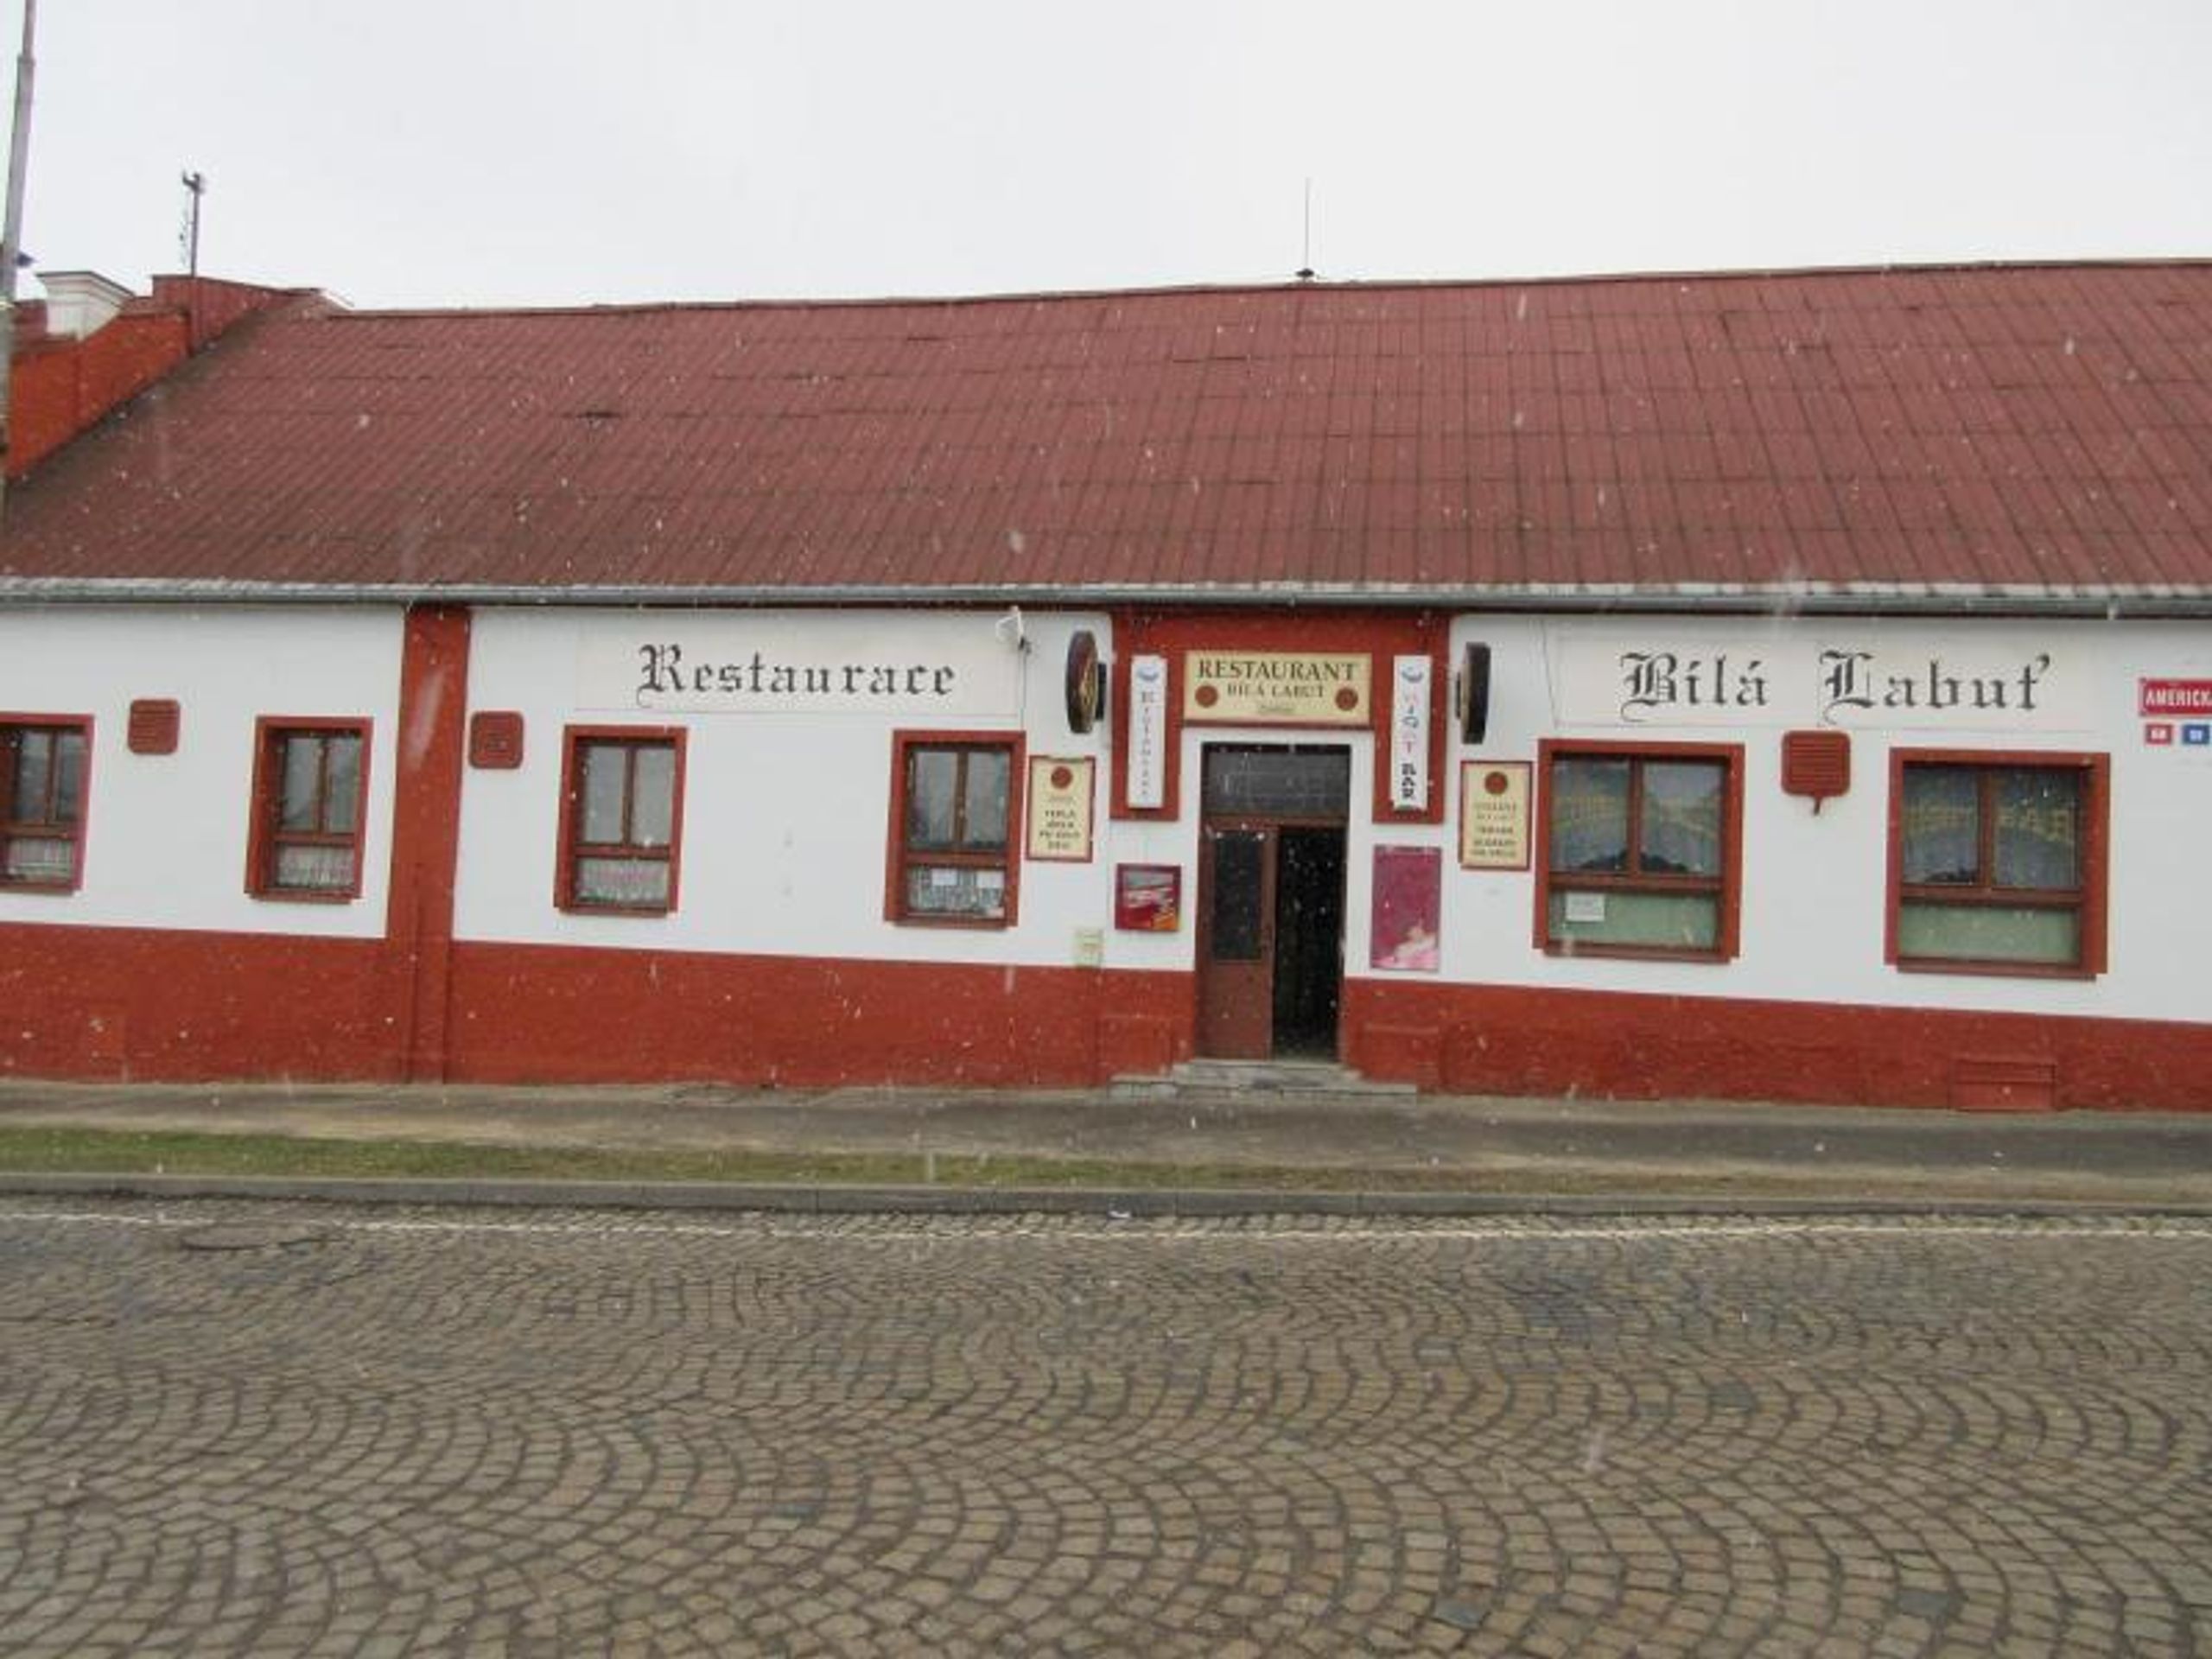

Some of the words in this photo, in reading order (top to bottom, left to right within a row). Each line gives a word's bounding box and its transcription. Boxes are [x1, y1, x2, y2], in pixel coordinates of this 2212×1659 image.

[637, 644, 955, 709] Restaurace
[1197, 659, 1360, 681] RESTAURANT
[1620, 652, 1770, 722] Bílá
[1818, 649, 2051, 725] Labuť
[2145, 688, 2212, 707] AMERICK
